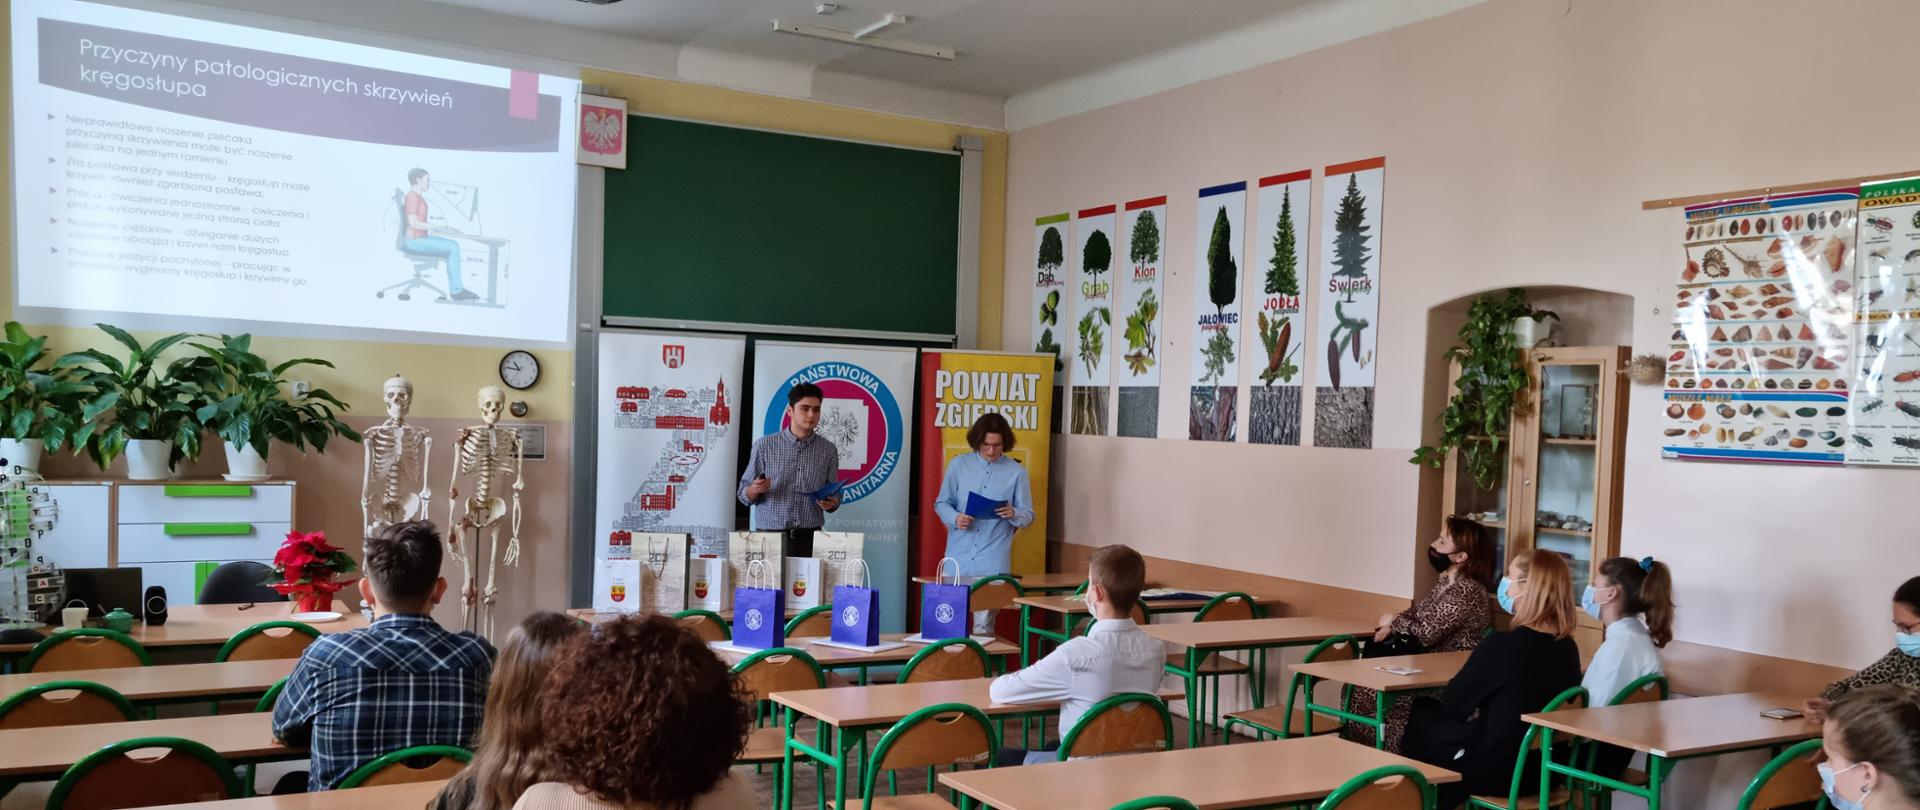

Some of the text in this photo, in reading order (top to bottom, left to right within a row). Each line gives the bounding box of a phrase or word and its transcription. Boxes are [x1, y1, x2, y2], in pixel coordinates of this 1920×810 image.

[80, 38, 453, 109] Przyczyny patologicznych skrzywień
[80, 64, 207, 98] kręgosłupa
[65, 113, 154, 134] Nieprawidłowe
[207, 132, 253, 145] plecaka
[117, 146, 133, 155] na
[135, 147, 178, 161] jednym
[191, 141, 222, 153] może
[247, 148, 294, 162] noszenie
[87, 160, 138, 174] postawa
[281, 180, 311, 192] może
[1865, 187, 1916, 199] POLSKA
[1134, 266, 1156, 279] Klon
[1081, 280, 1110, 296] Grab
[1328, 274, 1373, 293] Świerk
[1263, 295, 1300, 311] JODŁA
[1197, 312, 1239, 326] JAŁOWIEC
[789, 363, 880, 394] PAŃSTWOWA
[935, 369, 1041, 402] POWIAT
[842, 449, 898, 502] ANITARNA
[39, 579, 47, 587] A
